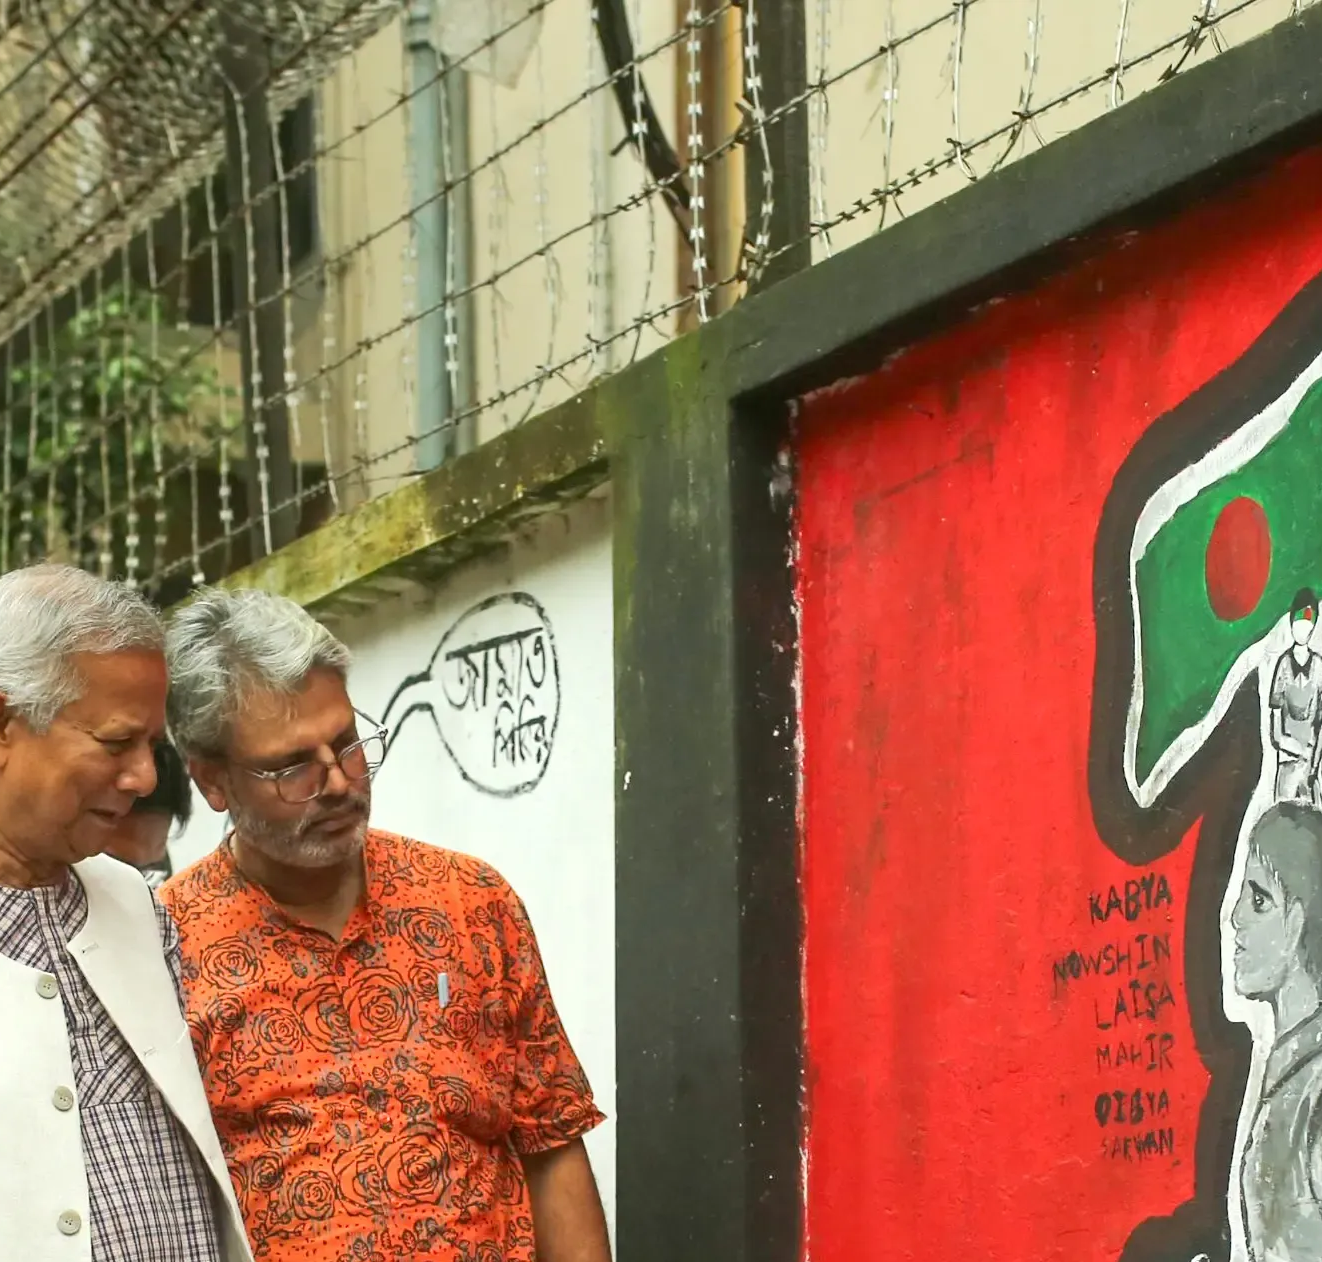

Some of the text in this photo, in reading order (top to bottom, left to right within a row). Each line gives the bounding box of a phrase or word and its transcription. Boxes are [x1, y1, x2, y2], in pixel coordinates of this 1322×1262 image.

[1089, 872, 1172, 925] KABYA
[1052, 933, 1171, 984] NOWSHIN
[1094, 979, 1176, 1030] LAISA
[1095, 1033, 1175, 1074] MAHIR
